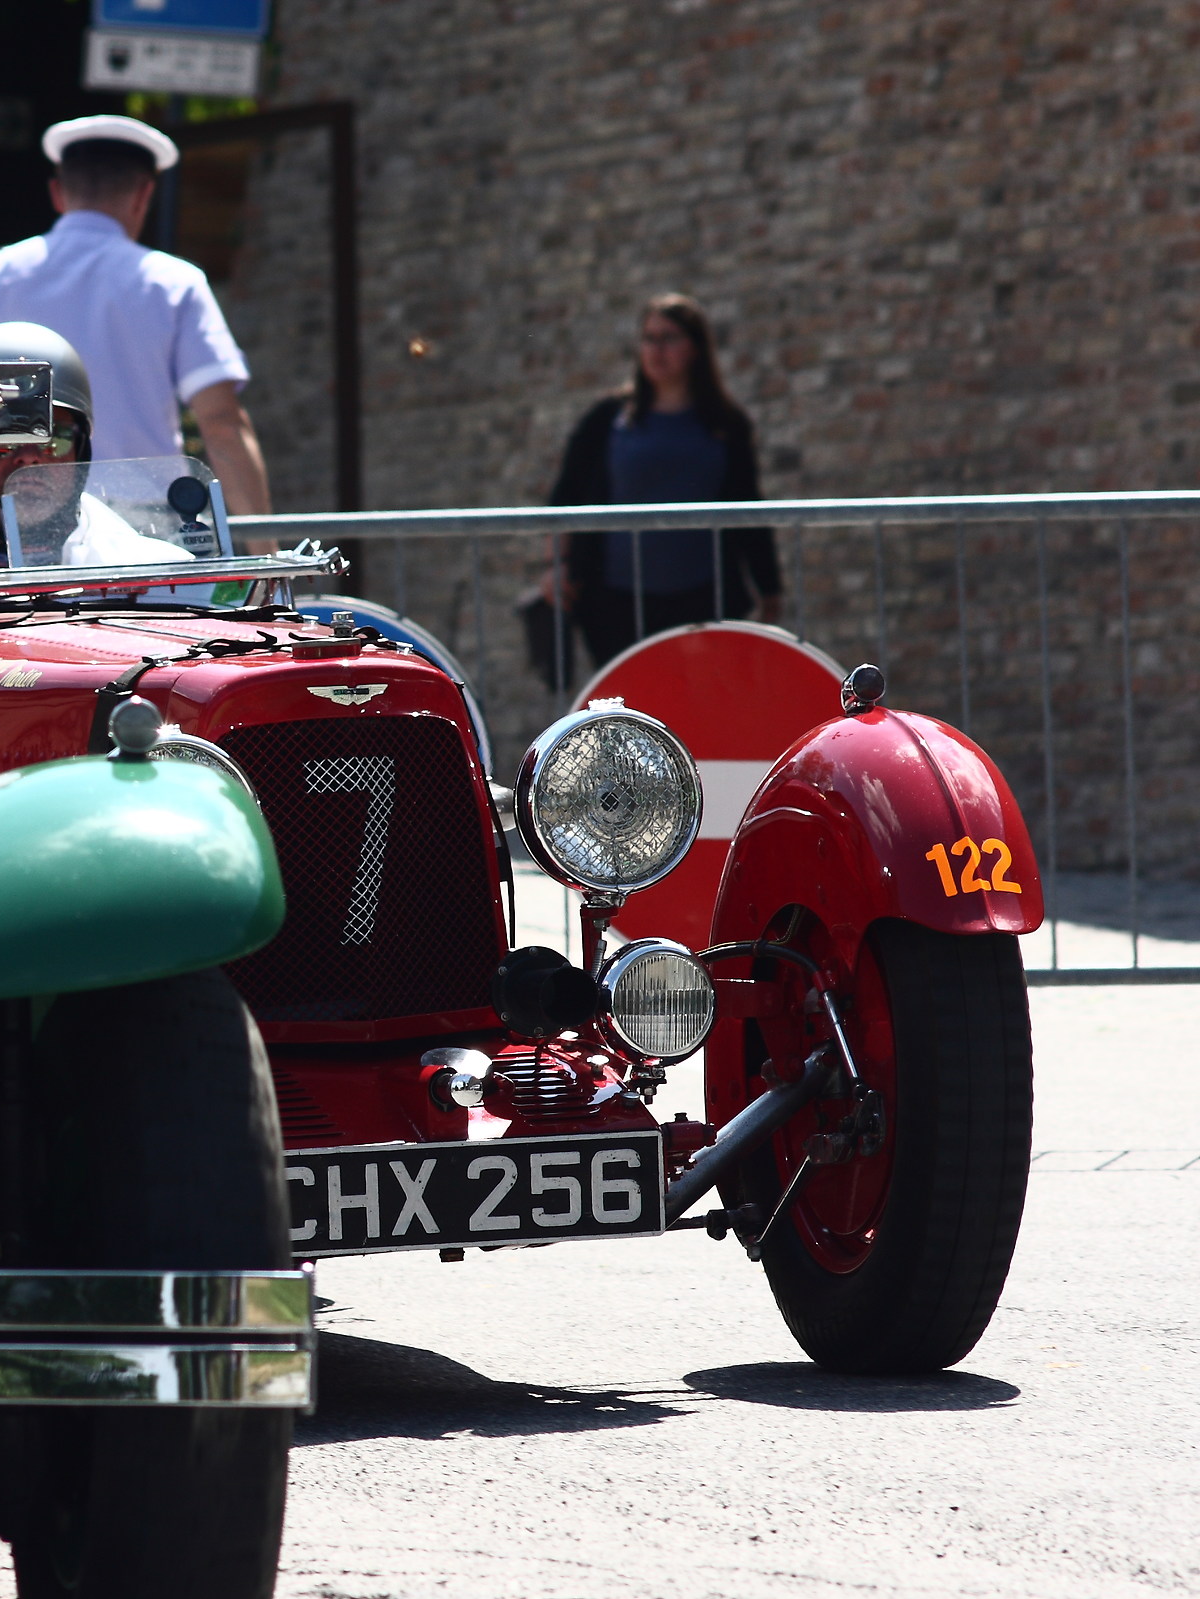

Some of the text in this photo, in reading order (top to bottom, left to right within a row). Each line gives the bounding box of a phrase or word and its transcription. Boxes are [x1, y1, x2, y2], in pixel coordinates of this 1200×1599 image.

[302, 755, 396, 946] 7
[925, 836, 1022, 897] 122
[284, 1148, 642, 1242] CHX 256
